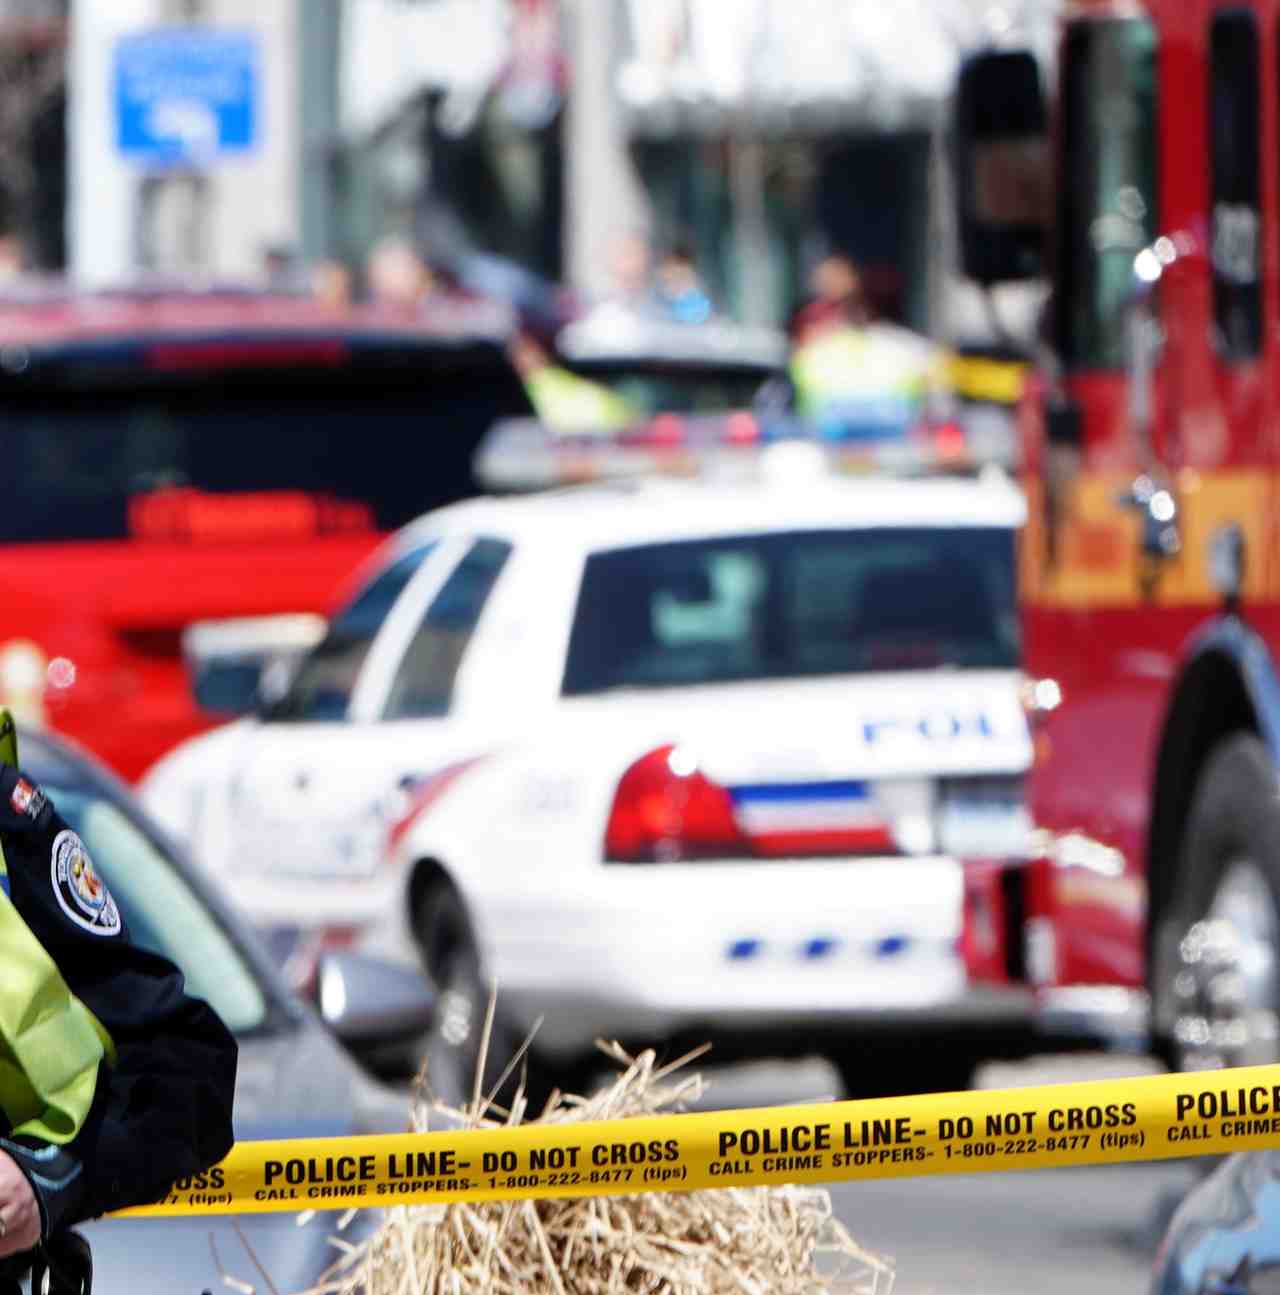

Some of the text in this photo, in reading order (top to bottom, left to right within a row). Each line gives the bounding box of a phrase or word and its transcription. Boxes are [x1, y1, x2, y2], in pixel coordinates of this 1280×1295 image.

[719, 1103, 1136, 1156] POLICE LINE- DO NOT CROSS
[1168, 1119, 1280, 1141] CALL CRIME
[264, 1140, 679, 1184] POLICE LINE- DO NOT CROSS
[709, 1131, 1145, 1176] CALL CRIME STOPPERS- 1-800-222-8477 (tips)
[254, 1188, 296, 1201] CALL
[308, 1183, 367, 1198] CRIME
[643, 1166, 687, 1183] (tips)
